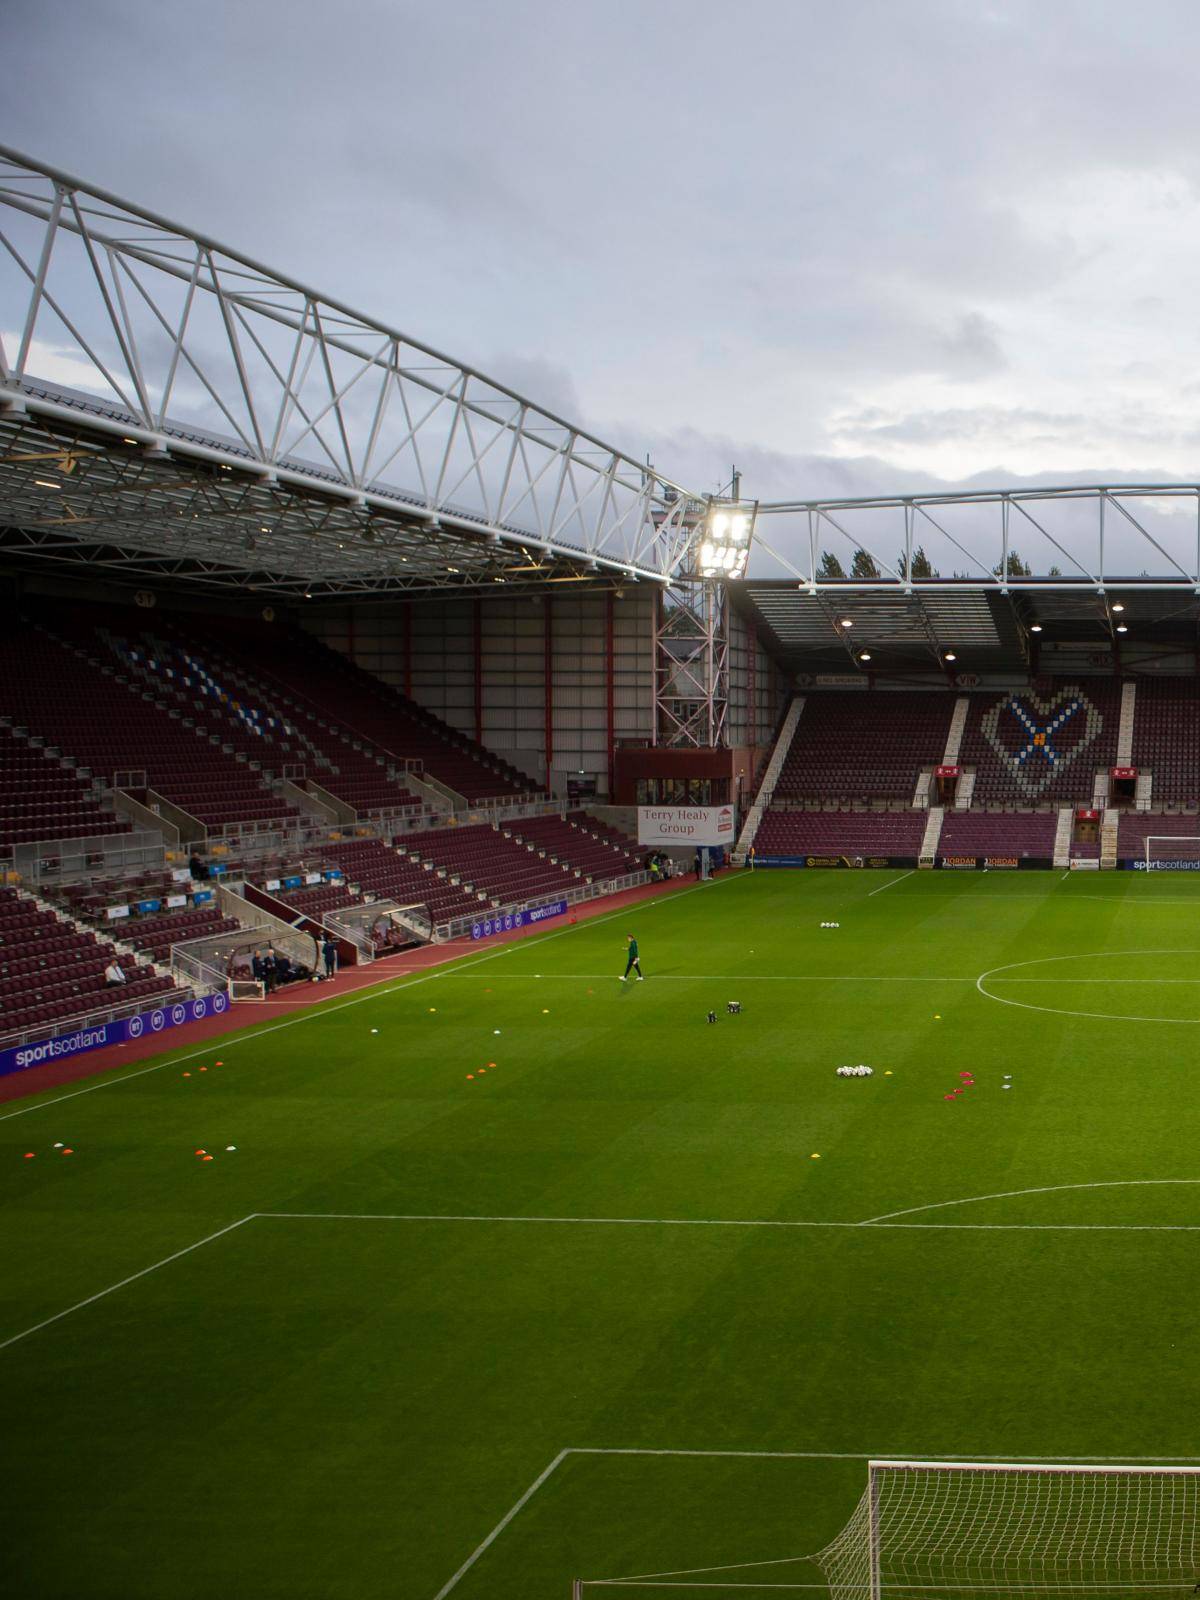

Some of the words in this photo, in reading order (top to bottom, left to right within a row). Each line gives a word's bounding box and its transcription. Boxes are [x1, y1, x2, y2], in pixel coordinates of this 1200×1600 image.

[644, 809, 674, 821] Terry
[678, 809, 709, 821] Healy
[659, 823, 695, 835] Group
[947, 857, 977, 865] JORDAN
[1133, 859, 1200, 871] sportscotland
[16, 1027, 107, 1067] sportscotland
